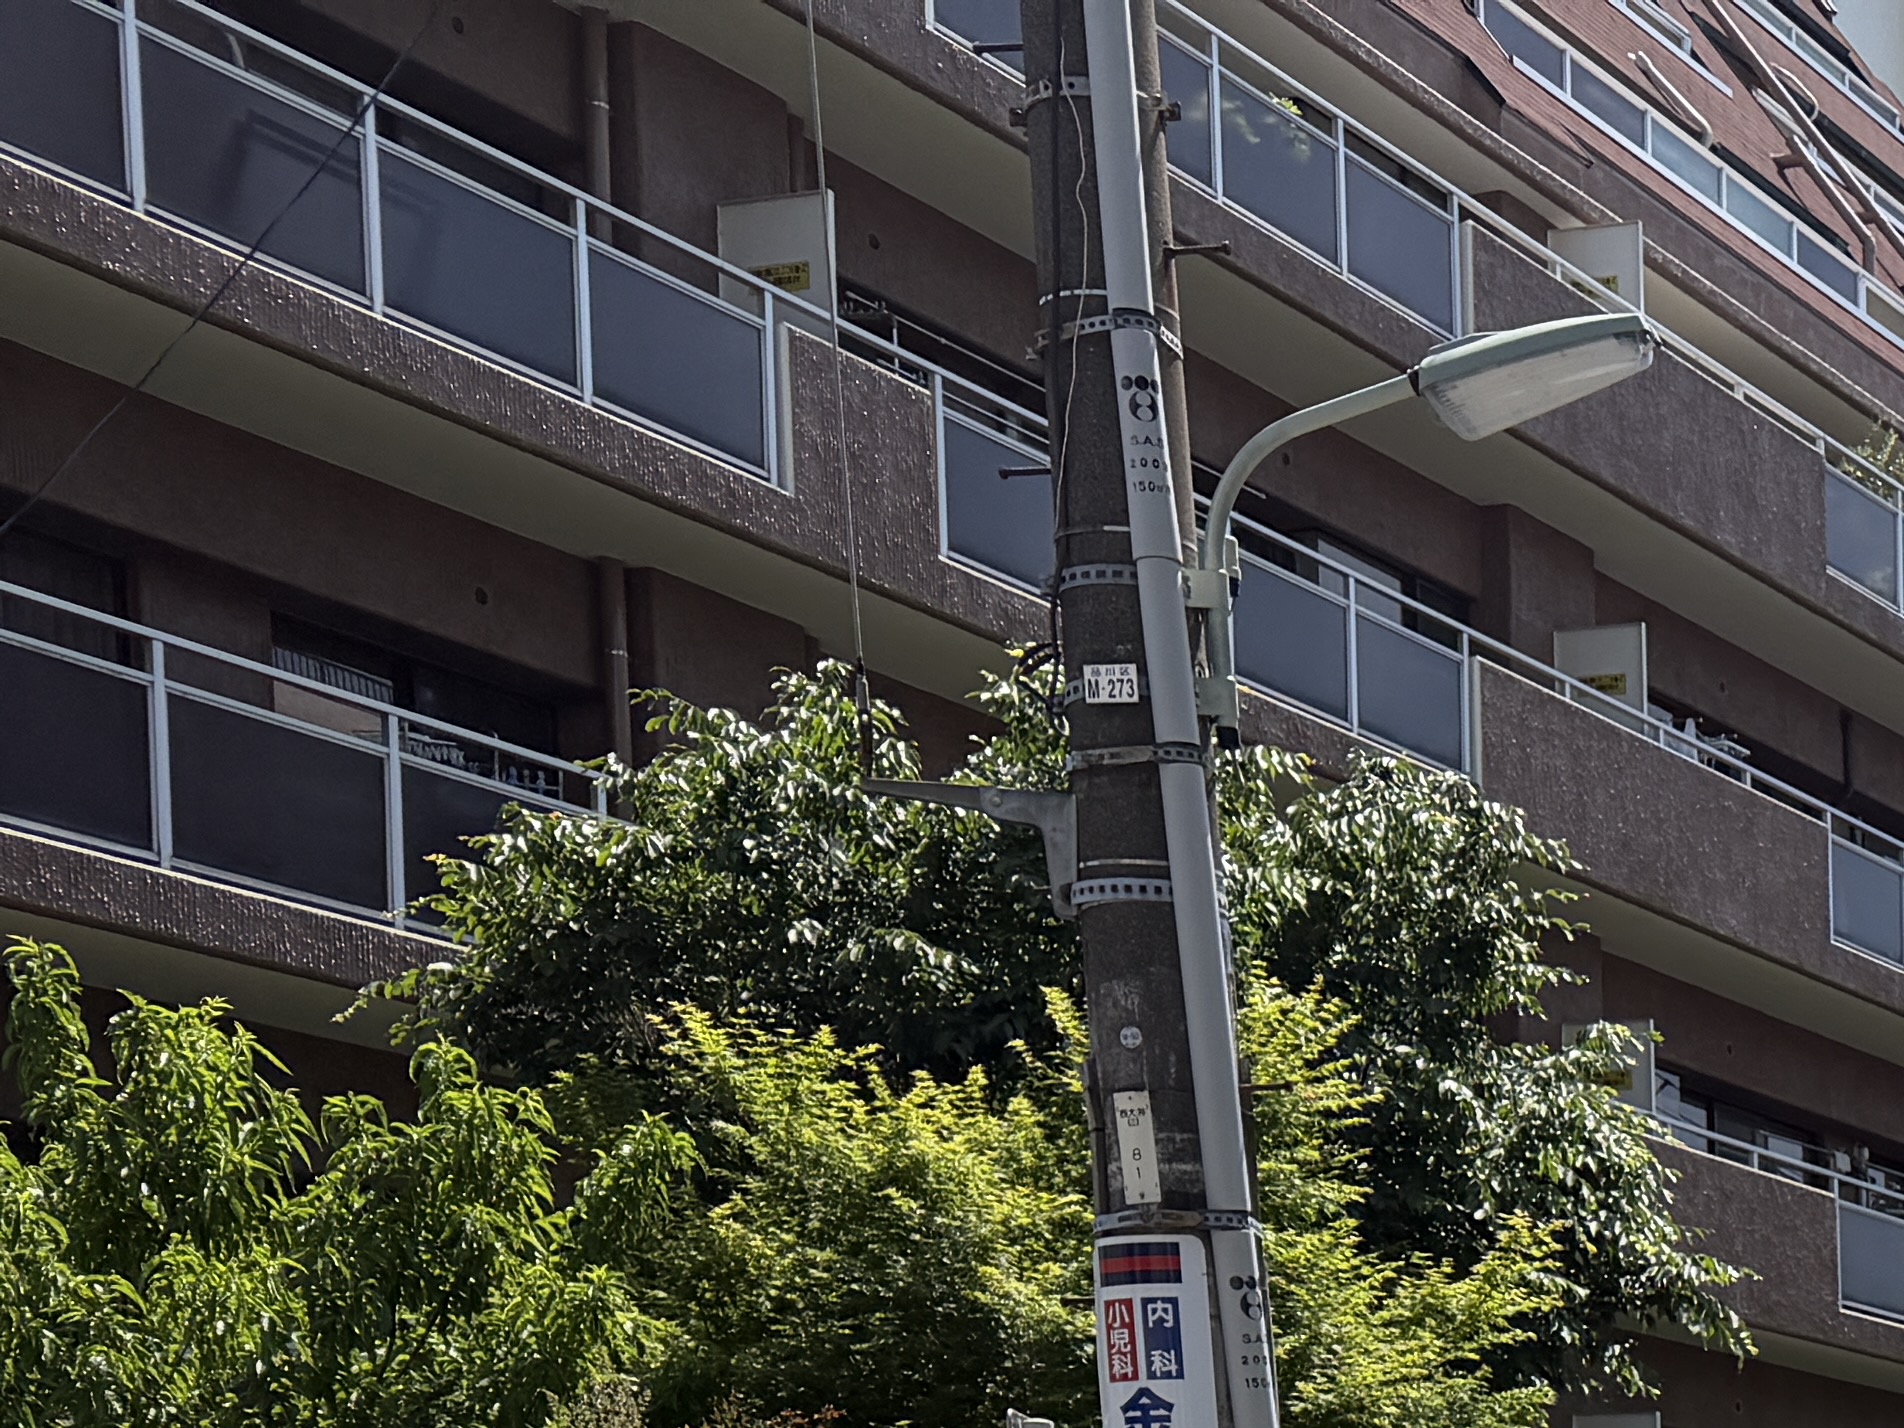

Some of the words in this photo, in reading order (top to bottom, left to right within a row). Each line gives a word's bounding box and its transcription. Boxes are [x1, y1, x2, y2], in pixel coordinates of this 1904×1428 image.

[1107, 1301, 1134, 1380] 小児科
[1146, 1300, 1179, 1378] 内科
